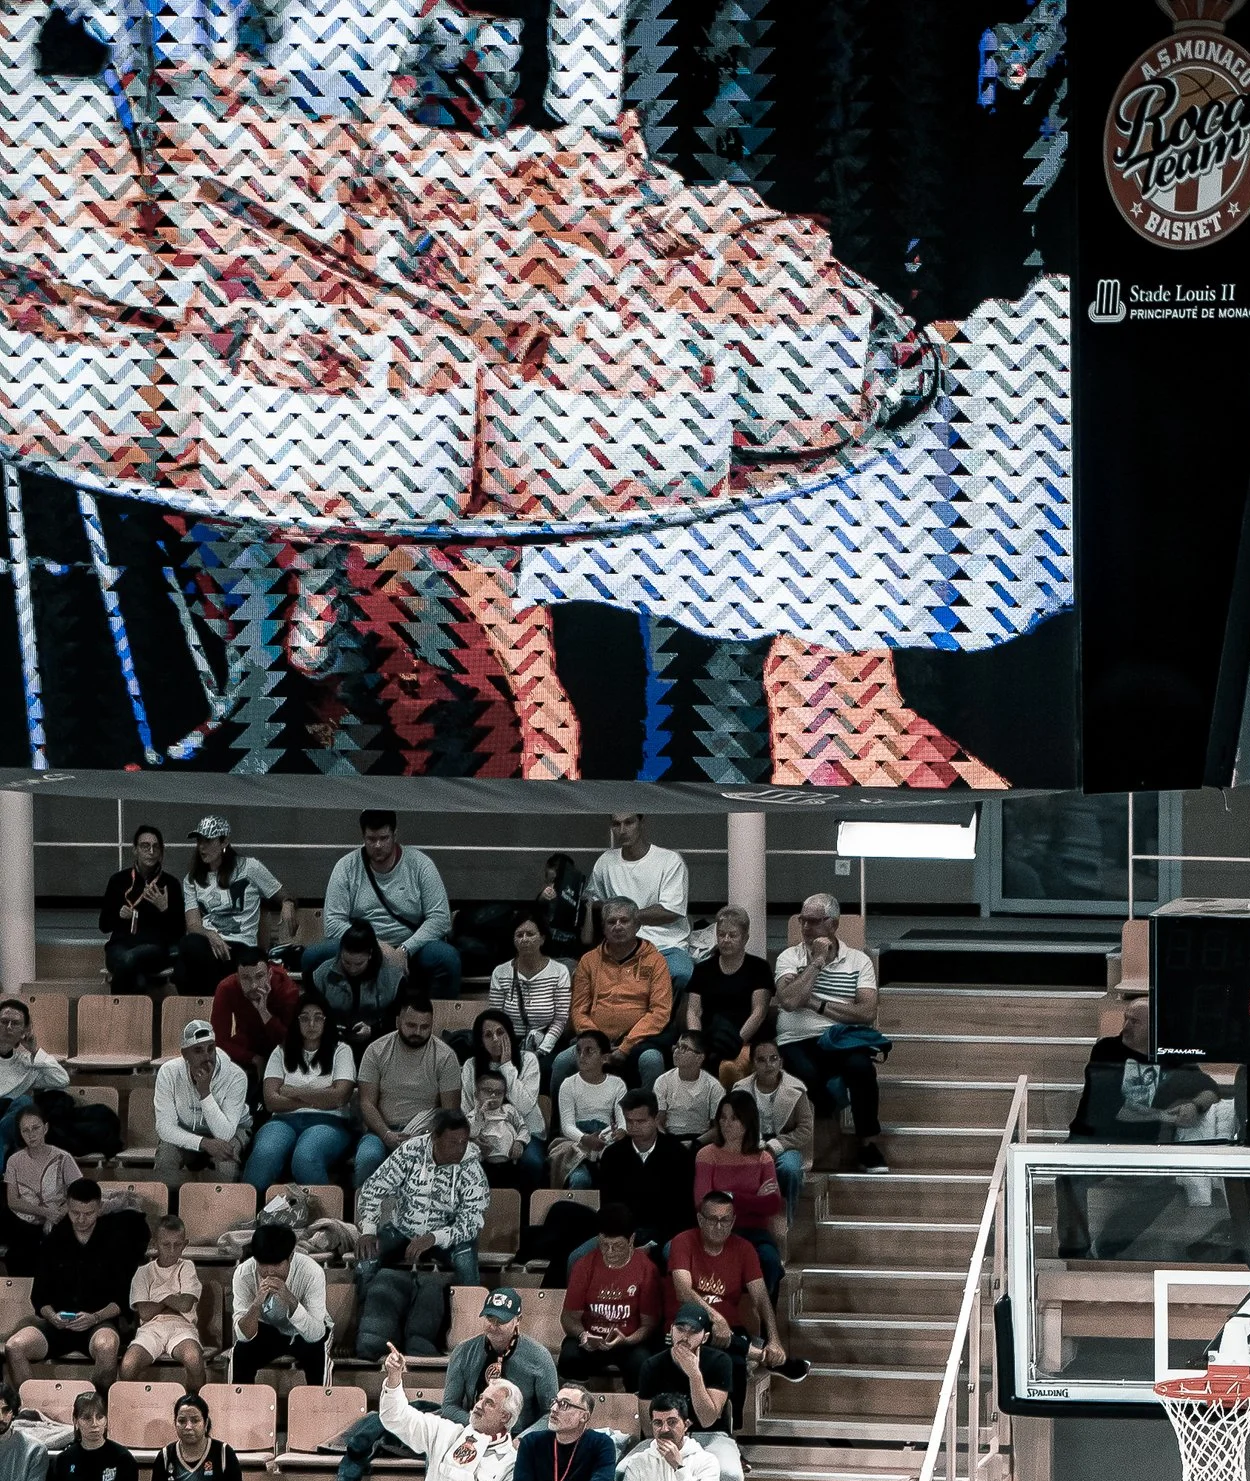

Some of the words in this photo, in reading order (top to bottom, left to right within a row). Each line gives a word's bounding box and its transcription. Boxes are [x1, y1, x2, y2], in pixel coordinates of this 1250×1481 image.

[1123, 128, 1250, 200] Team
[1144, 211, 1222, 241] BASKET
[1130, 285, 1173, 302] Stade
[1176, 285, 1216, 302] Louis
[1221, 284, 1236, 301] II
[1130, 306, 1198, 320] PRINCIPAUTÉ
[1201, 308, 1215, 319] DE
[1157, 1047, 1206, 1056] STRAMATEL
[1027, 1388, 1069, 1398] SPALDING
